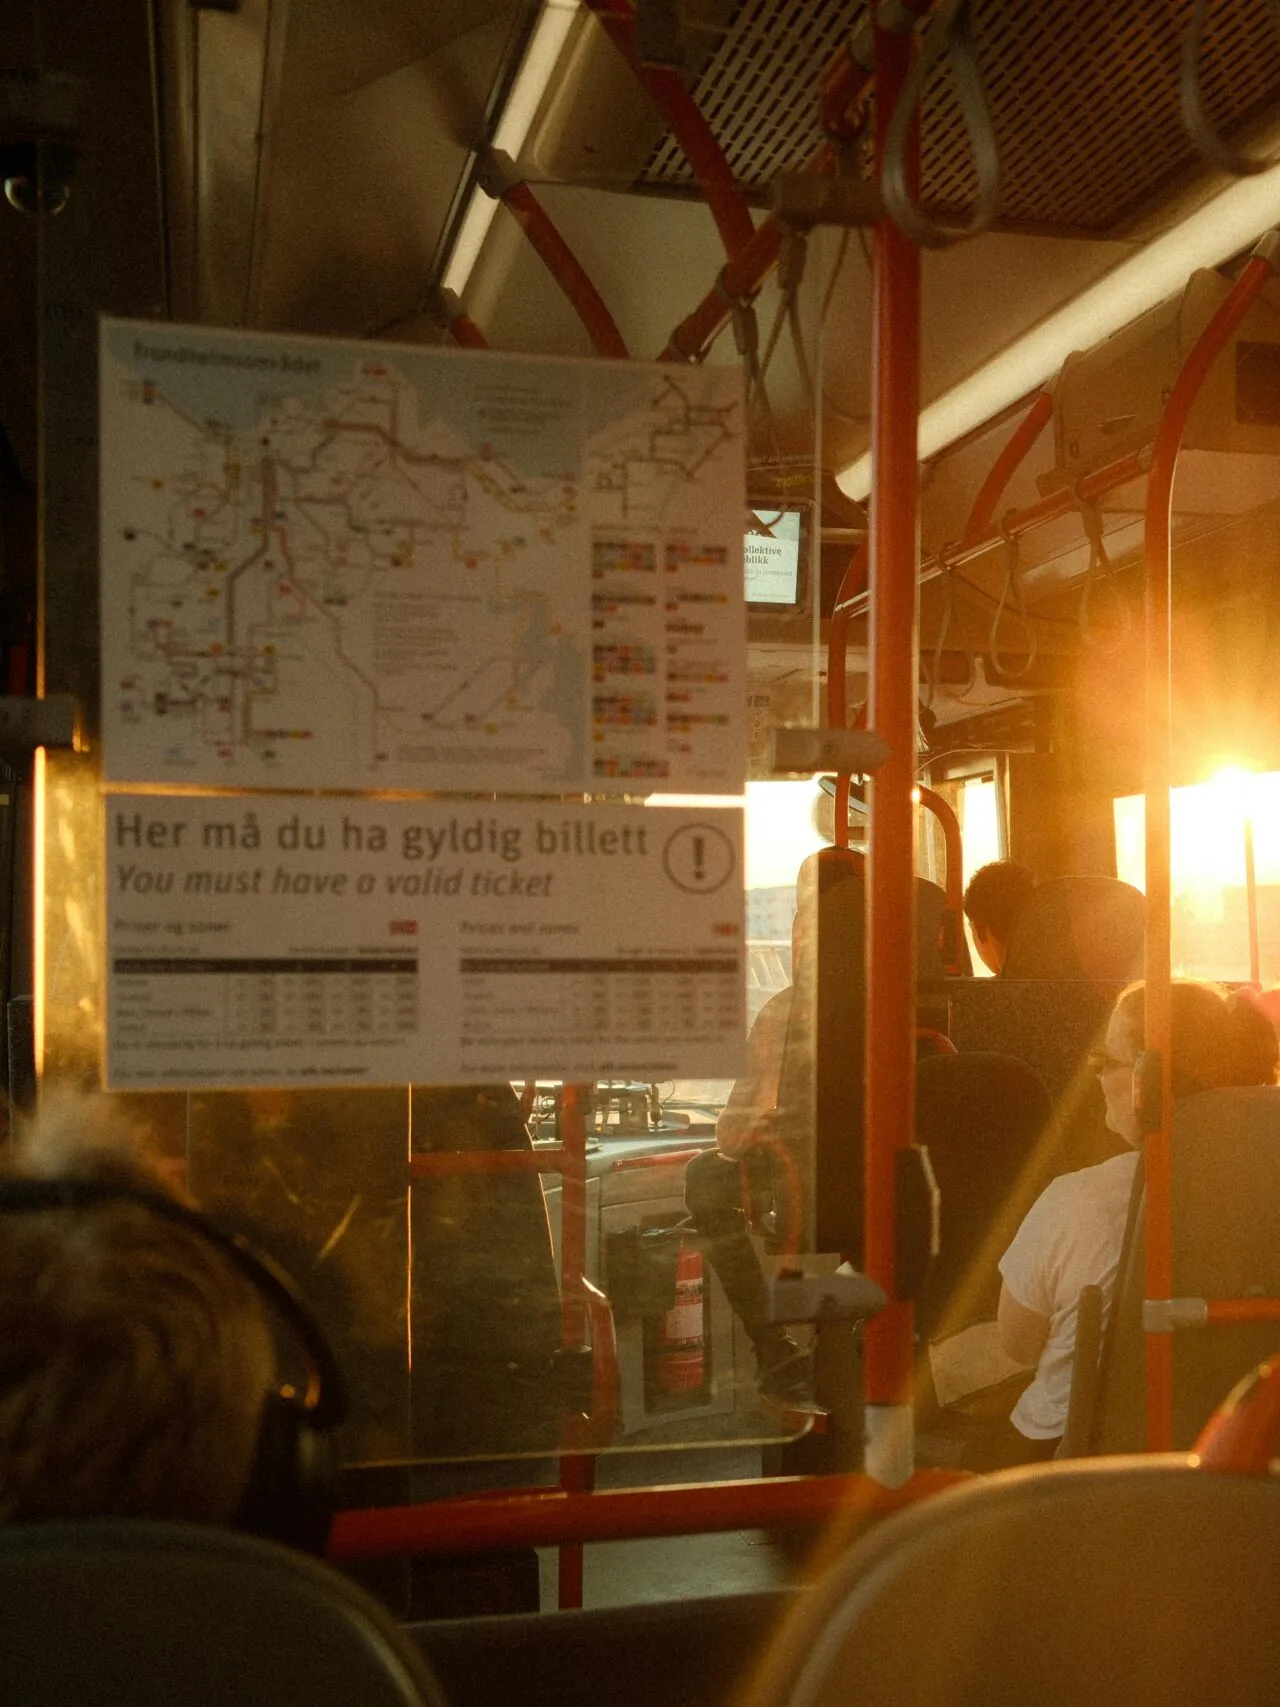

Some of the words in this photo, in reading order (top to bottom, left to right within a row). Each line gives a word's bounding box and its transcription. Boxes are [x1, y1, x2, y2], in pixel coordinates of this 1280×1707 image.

[745, 556, 769, 565] blikk
[115, 813, 187, 849] Her
[203, 812, 261, 850] må
[277, 815, 326, 851] du
[342, 816, 388, 852] ha
[402, 819, 522, 863] gyldig
[536, 820, 649, 856] billett
[116, 864, 175, 894] You
[183, 867, 262, 895] must
[272, 867, 349, 896] have
[356, 872, 377, 896] a
[385, 867, 465, 897] valid
[470, 869, 553, 898] ticket
